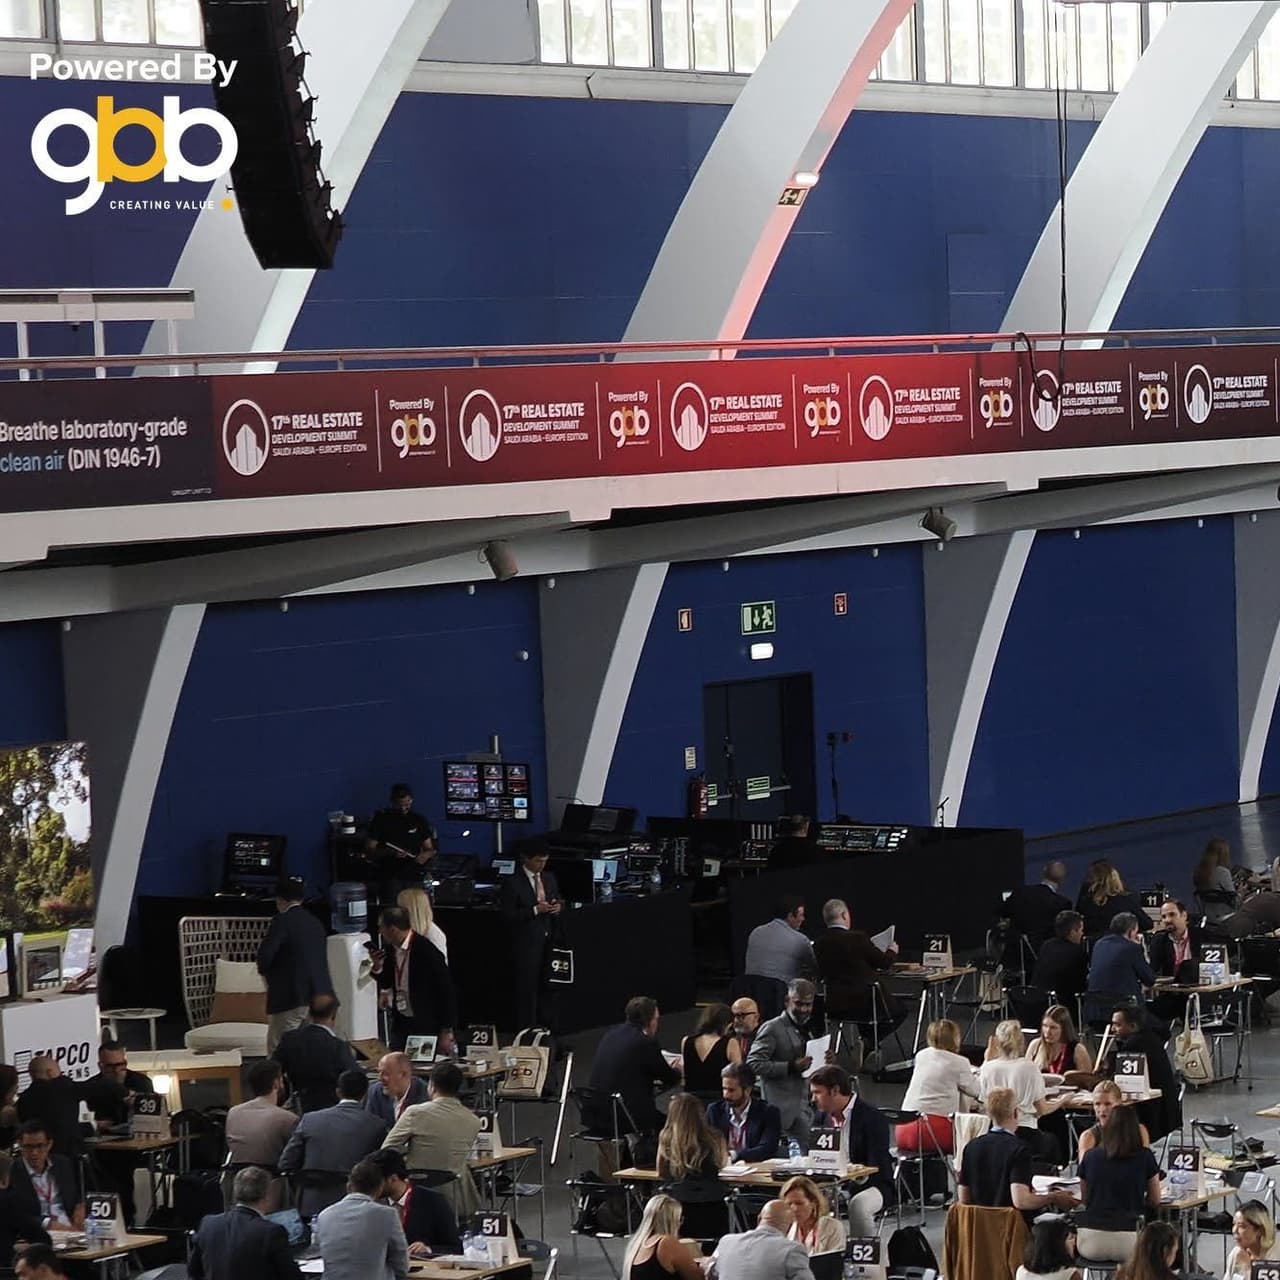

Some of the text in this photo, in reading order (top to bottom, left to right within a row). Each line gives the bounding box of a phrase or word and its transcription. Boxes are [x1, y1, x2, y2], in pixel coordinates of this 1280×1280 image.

[608, 391, 649, 404] Powered By
[727, 395, 749, 410] REAL
[749, 394, 783, 409] ESTATE
[909, 387, 961, 402] REAL ESTATE
[389, 399, 434, 411] Powered By
[521, 404, 548, 419] REAL
[548, 402, 585, 417] ESTATE
[292, 414, 321, 430] REAL
[322, 412, 363, 428] ESTATE
[503, 419, 580, 433] DEVELOPMENT SUMMIT
[0, 417, 188, 443] Breathe laboratory-grade
[271, 430, 358, 444] DEVELOPMENT SUMMIT
[0, 445, 161, 473] clean air (DIN 1946-7)
[1146, 896, 1157, 906] 11
[929, 939, 943, 951] 21
[1204, 950, 1221, 962] 22
[472, 1031, 489, 1043] 29
[1122, 1060, 1139, 1074] 31
[139, 1099, 156, 1112] 39
[816, 1134, 834, 1149] 41
[1173, 1154, 1193, 1169] 42
[91, 1201, 111, 1217] 50
[482, 1218, 500, 1234] 51
[853, 1245, 873, 1260] 52
